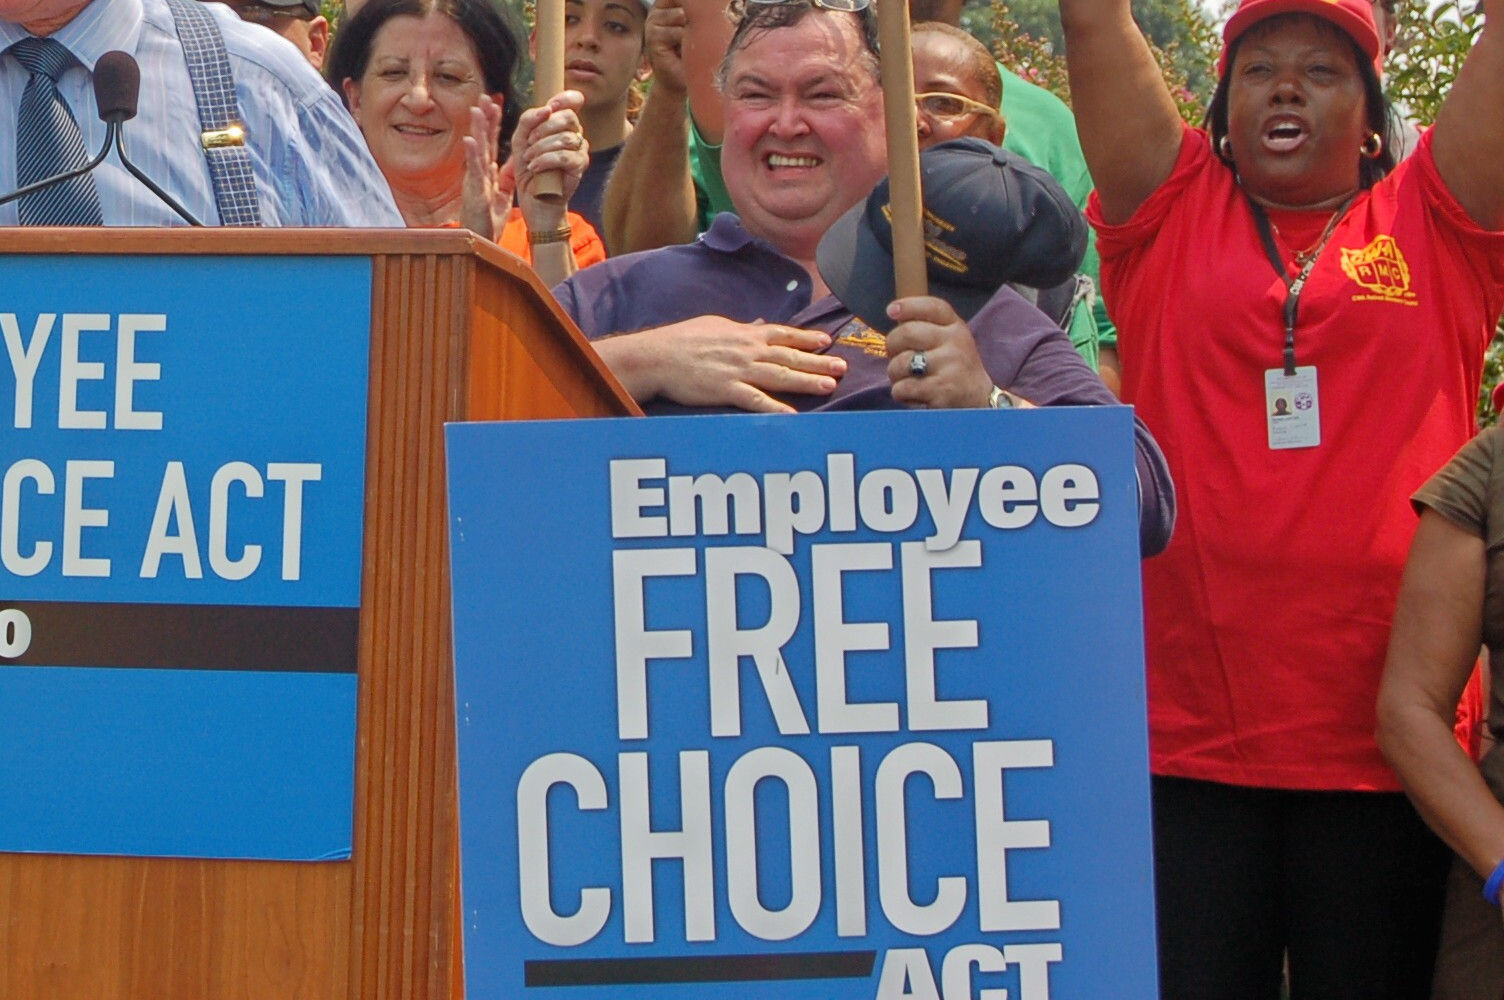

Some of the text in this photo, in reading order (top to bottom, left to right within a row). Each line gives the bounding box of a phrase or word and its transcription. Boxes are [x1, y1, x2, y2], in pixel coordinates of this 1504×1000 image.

[140, 461, 322, 581] ACT
[609, 452, 1100, 555] Employee
[612, 540, 990, 740] FREE
[516, 739, 1061, 947] CHOICE
[874, 942, 1063, 1000] ACT
